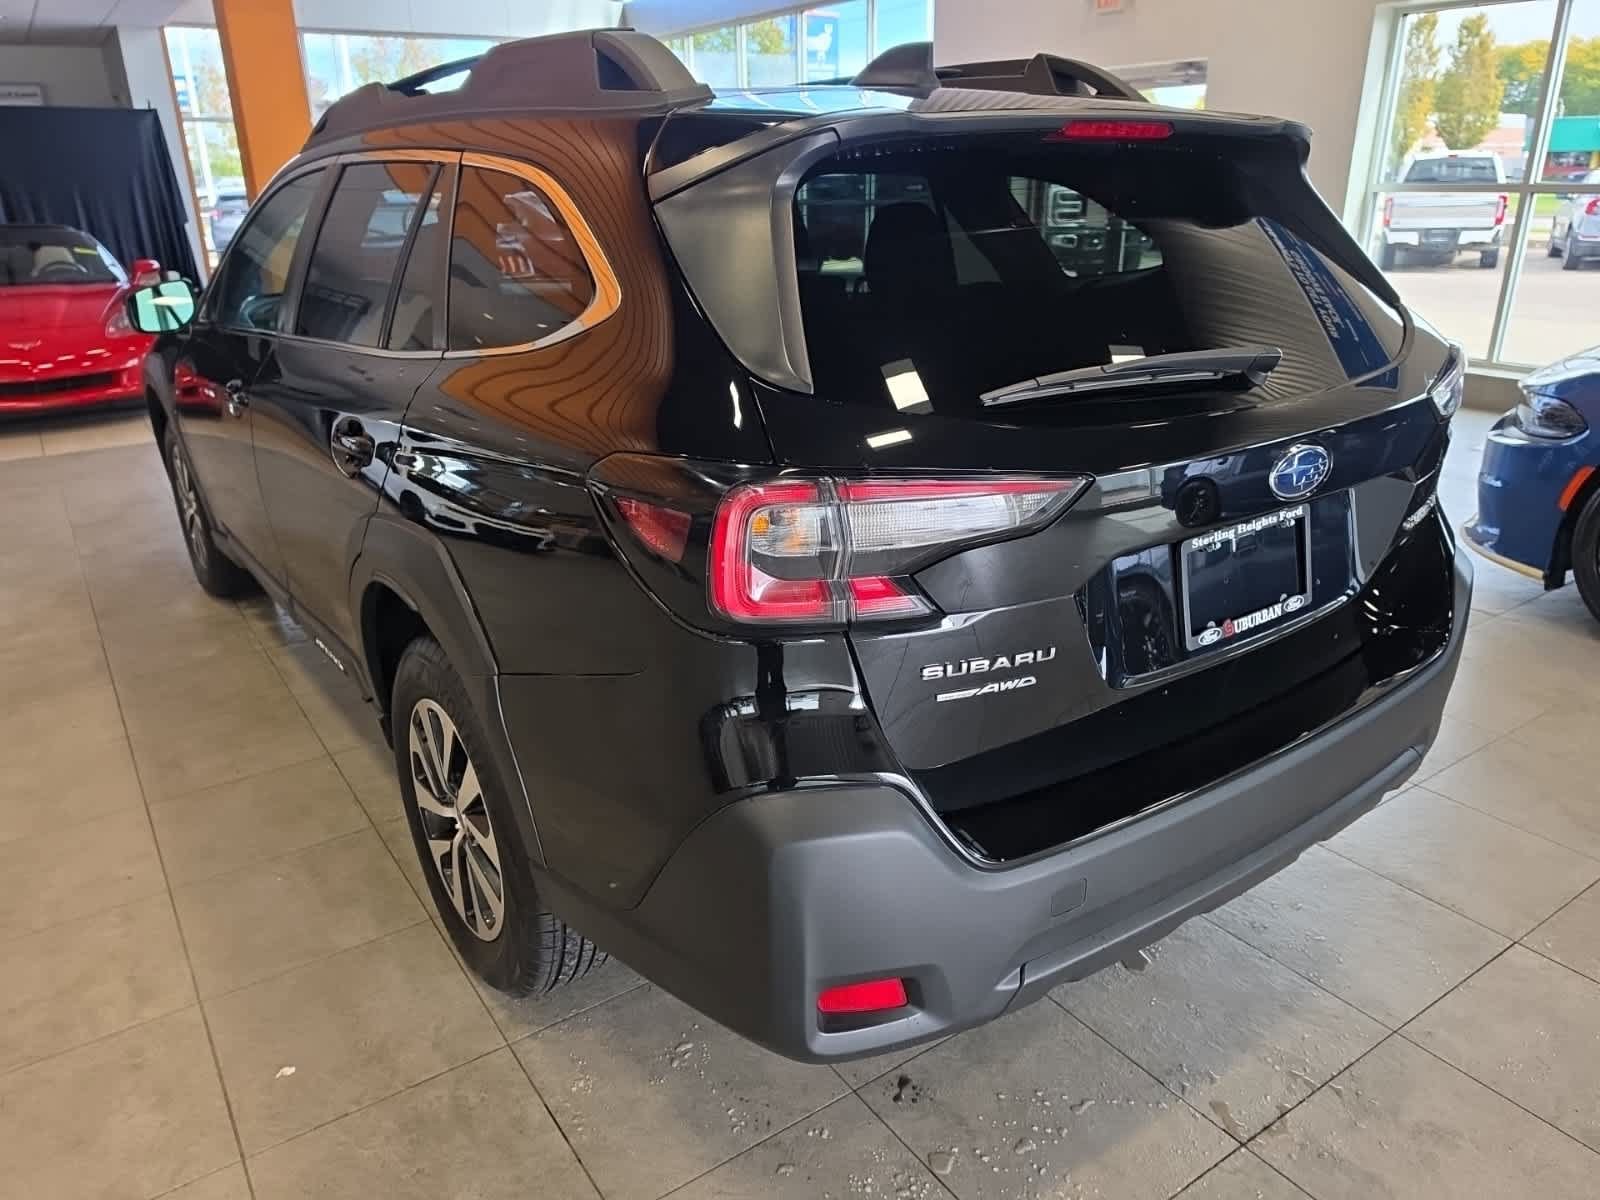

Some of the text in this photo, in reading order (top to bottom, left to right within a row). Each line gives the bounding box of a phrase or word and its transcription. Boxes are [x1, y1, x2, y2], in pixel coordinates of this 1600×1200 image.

[1191, 505, 1303, 549] Sterling Heights Ford
[1222, 603, 1283, 638] SUBURBAN
[922, 647, 1056, 681] SUBARU
[975, 676, 1037, 696] AWD
